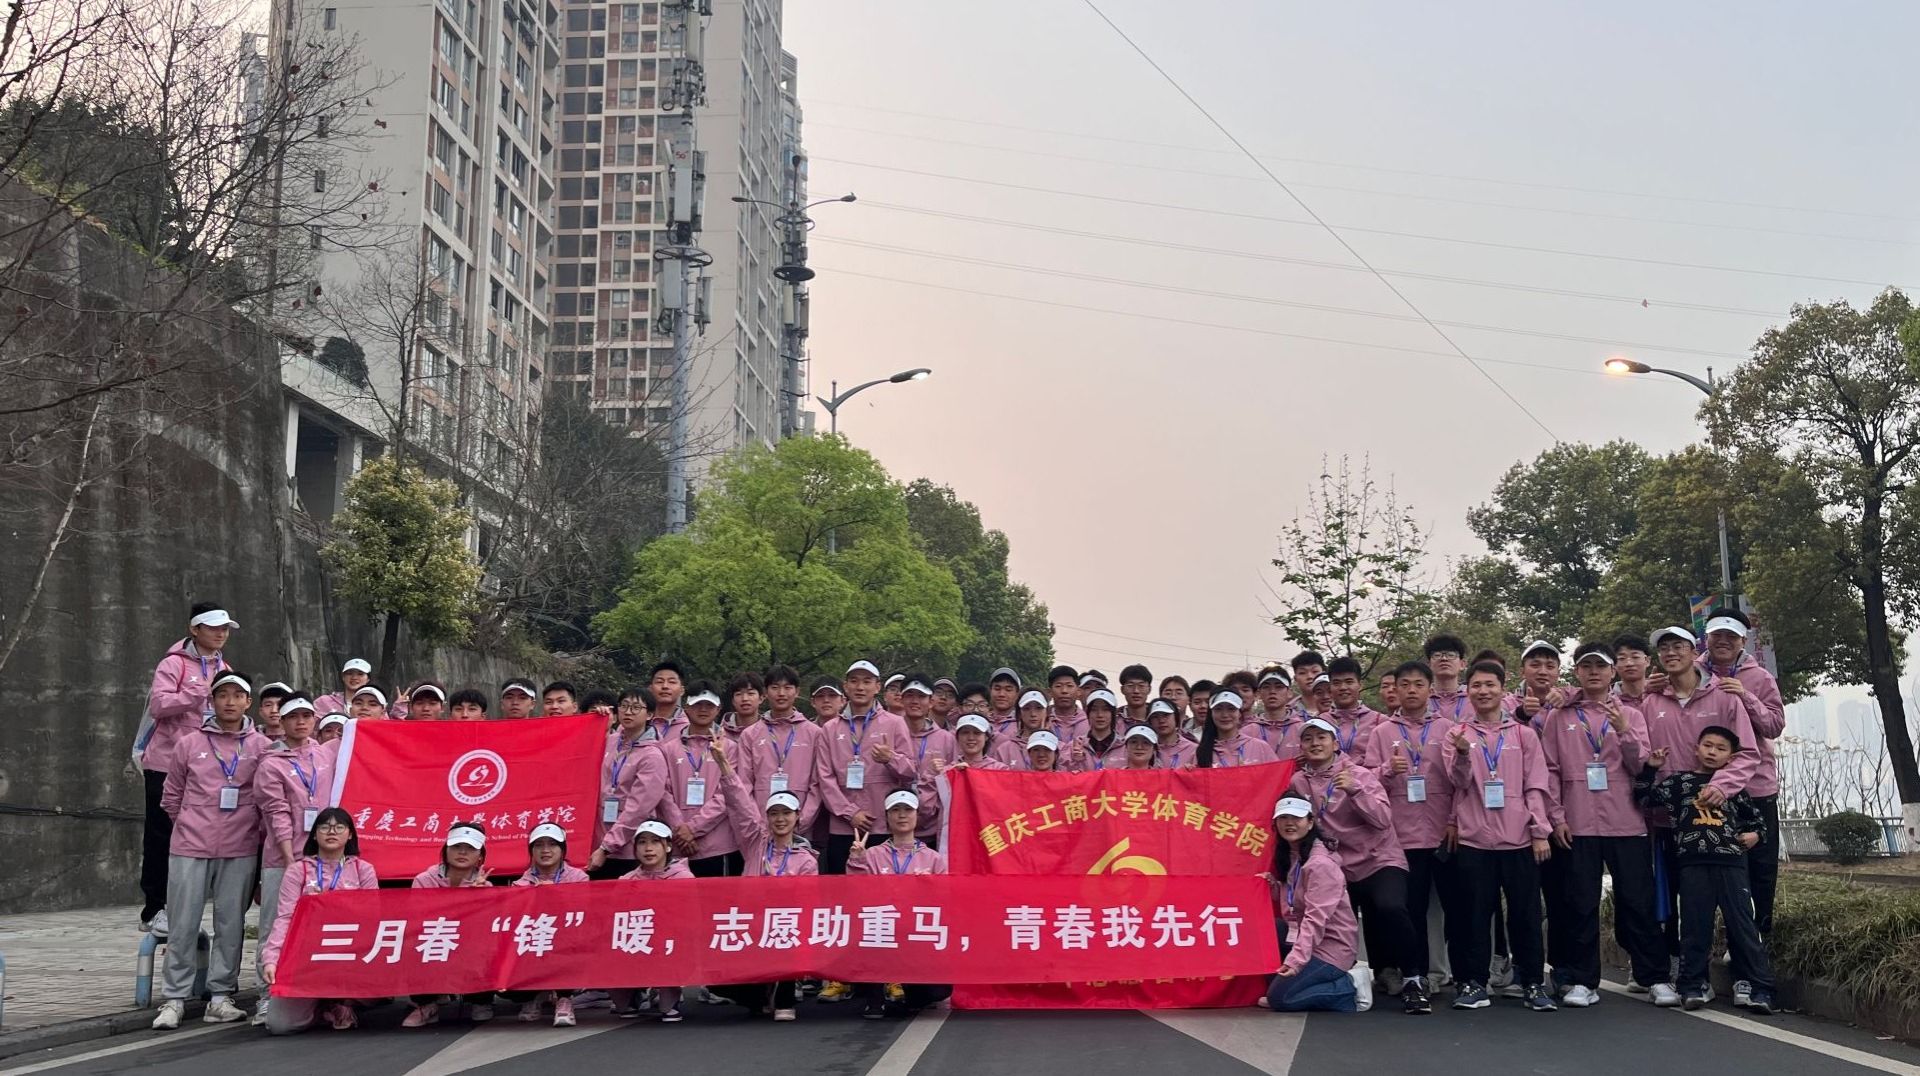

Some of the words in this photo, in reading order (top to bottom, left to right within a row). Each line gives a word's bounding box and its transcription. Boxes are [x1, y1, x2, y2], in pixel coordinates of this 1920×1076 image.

[979, 790, 1270, 857] 重庆工商大学体育学院
